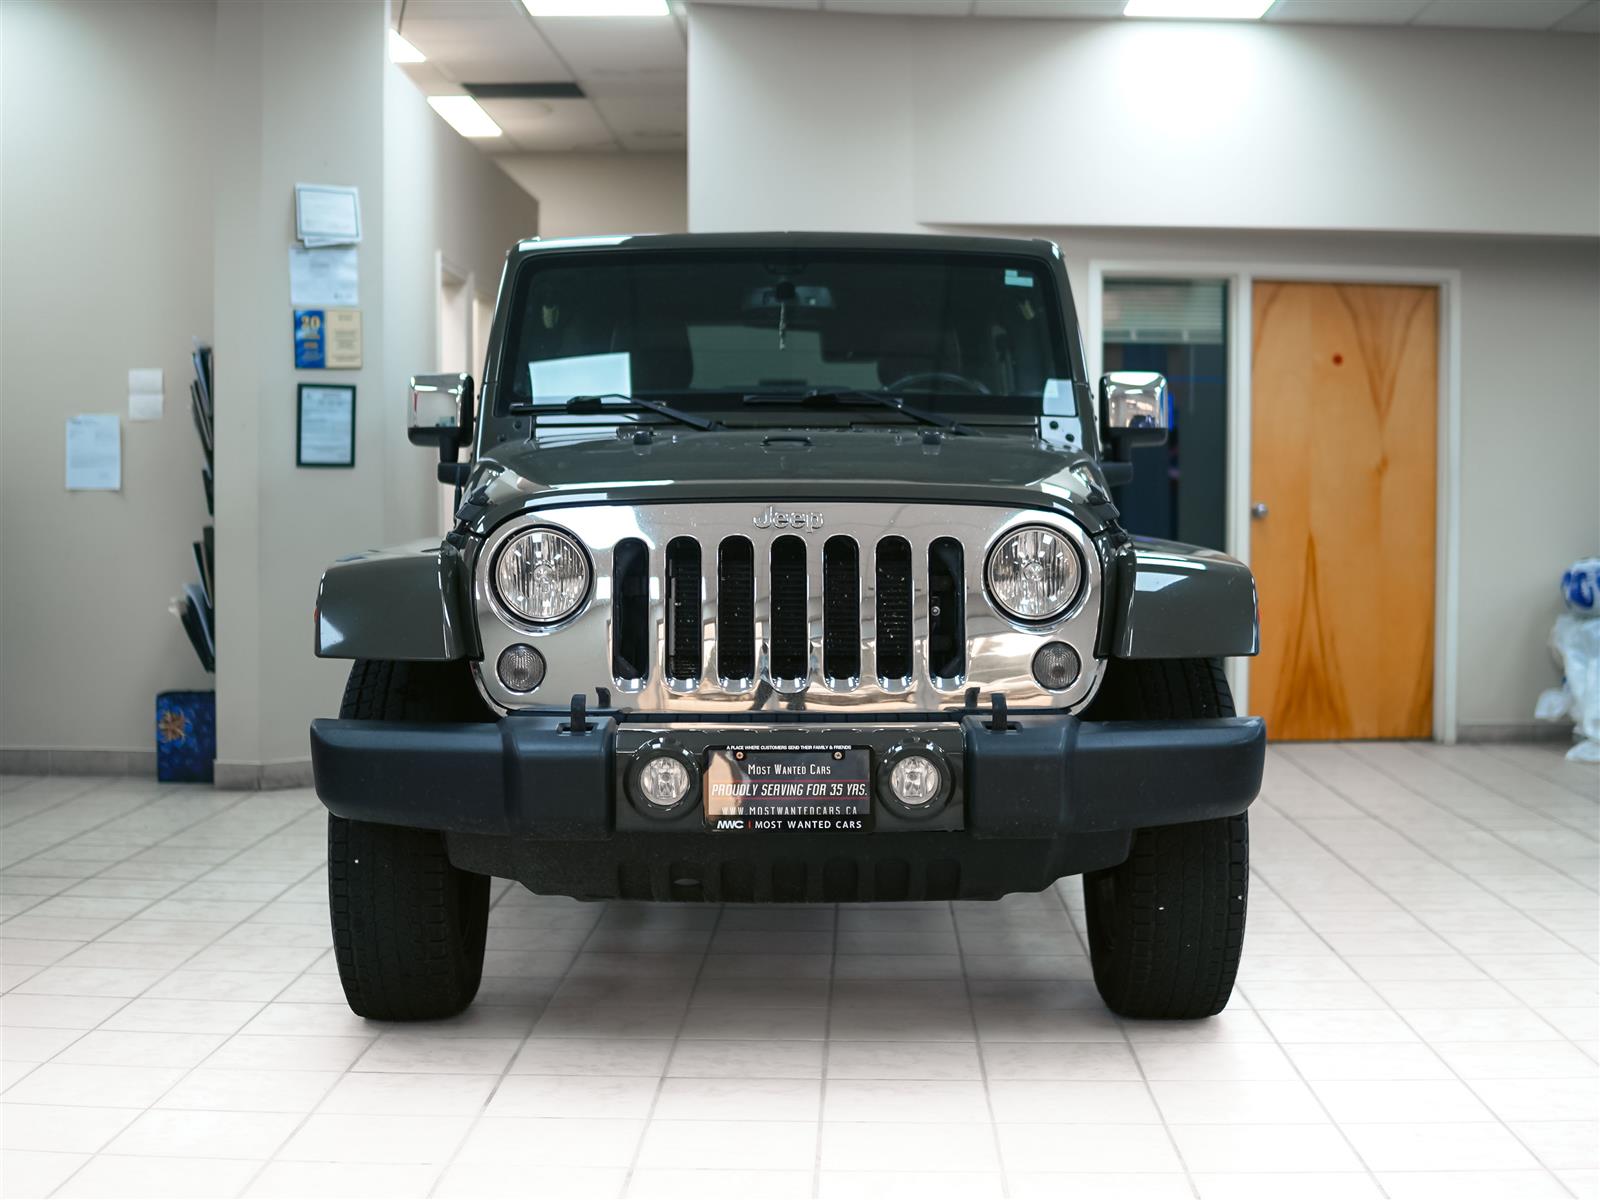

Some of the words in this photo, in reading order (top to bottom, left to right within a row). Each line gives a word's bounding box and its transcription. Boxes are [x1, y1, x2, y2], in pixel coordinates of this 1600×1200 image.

[752, 505, 824, 534] Jeep
[711, 783, 759, 796] PROUDLY
[761, 783, 804, 796] SERVING
[806, 783, 827, 796] FOR
[829, 783, 844, 796] 35
[847, 783, 868, 796] YRS.
[721, 806, 858, 816] WWWMOSTWANTEDCARSCA
[754, 820, 783, 829] MOST
[787, 820, 832, 829] WANTED
[835, 820, 862, 829] CARS
